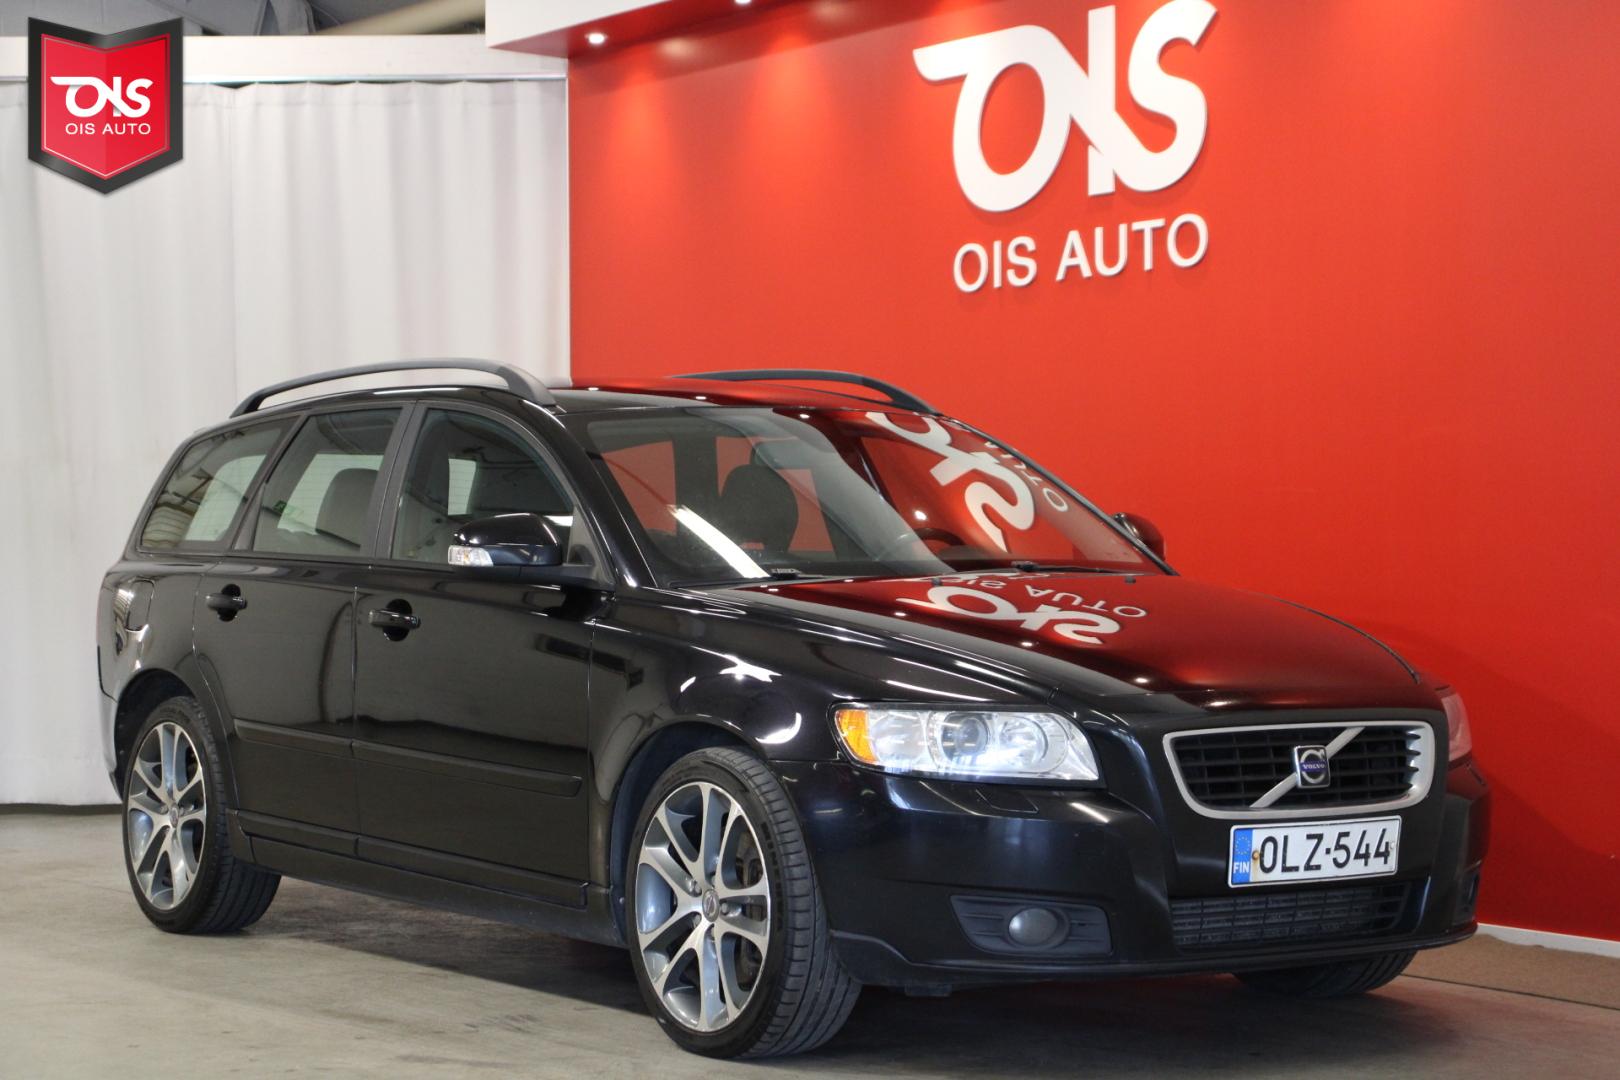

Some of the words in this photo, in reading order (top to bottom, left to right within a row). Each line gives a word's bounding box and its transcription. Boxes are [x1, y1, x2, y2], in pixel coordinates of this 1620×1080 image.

[953, 235, 1038, 293] OIS
[1055, 212, 1209, 282] AUTO
[1232, 861, 1250, 874] FIN
[1259, 828, 1391, 874] OLZ-544
